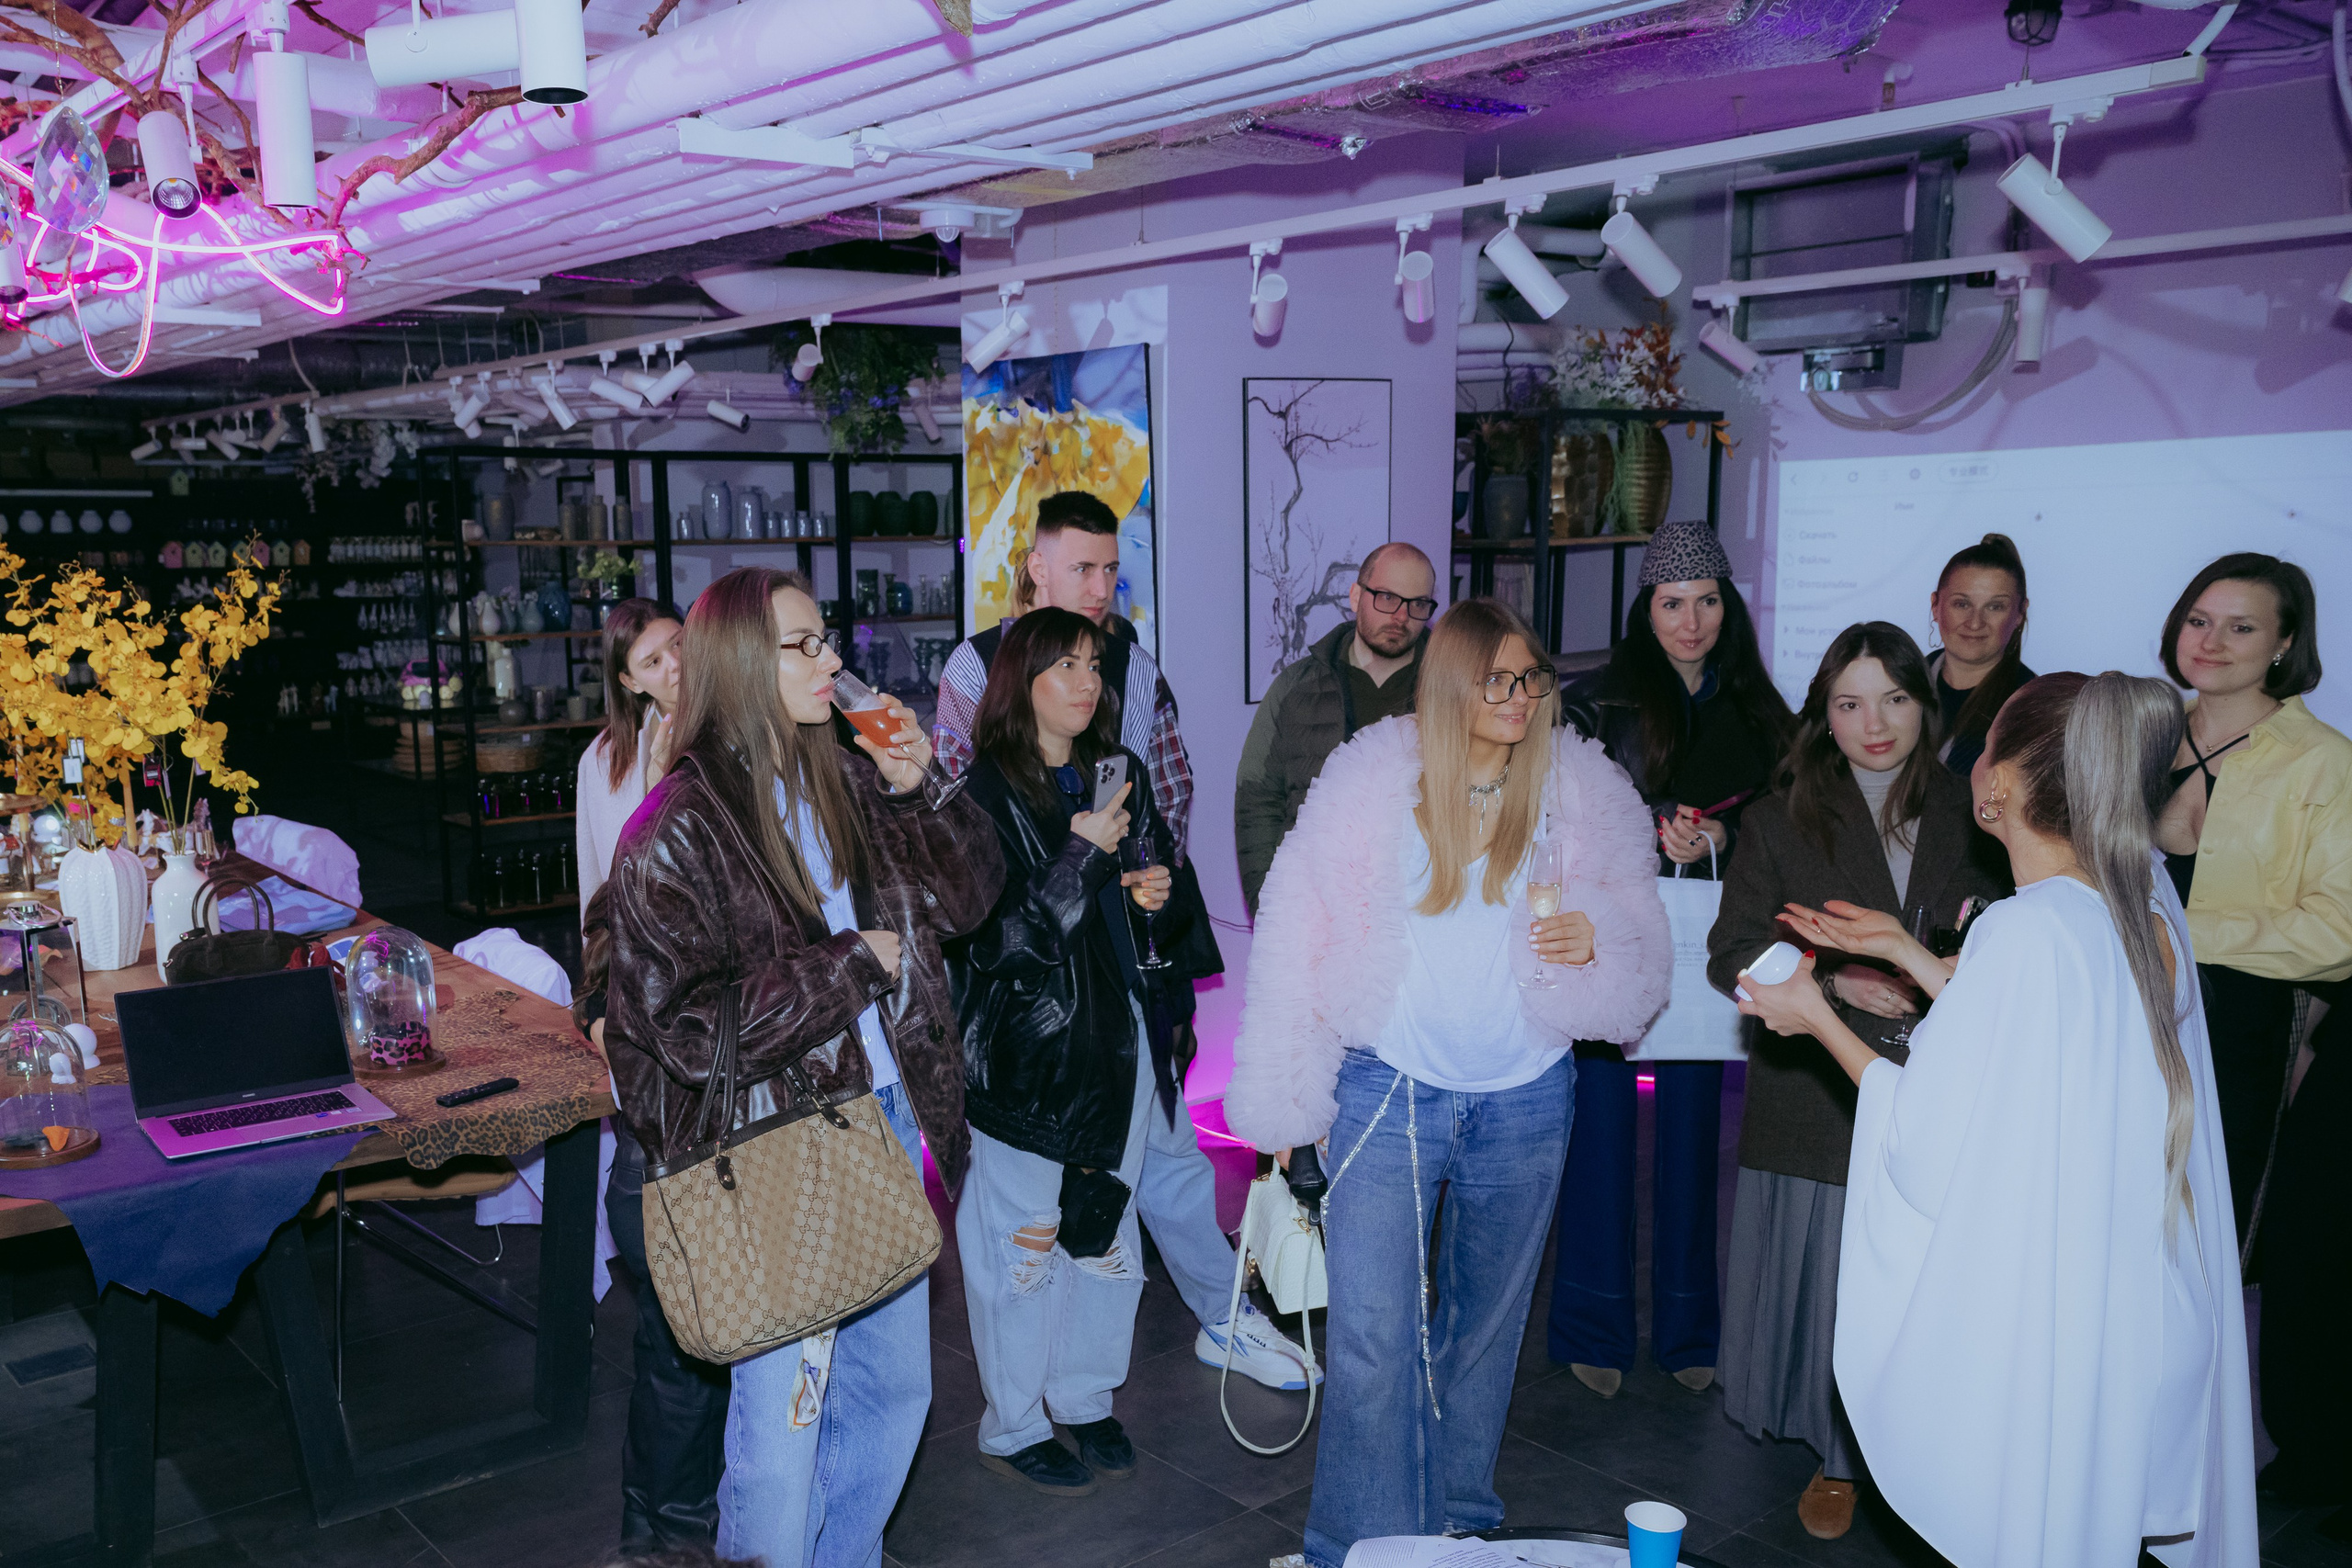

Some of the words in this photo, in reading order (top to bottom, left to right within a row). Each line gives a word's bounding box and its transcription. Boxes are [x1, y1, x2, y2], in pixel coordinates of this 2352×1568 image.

[1798, 529, 1838, 540] Скачать
[1797, 554, 1832, 565] Файлы
[1796, 579, 1858, 590] Фотоальбом
[1795, 626, 1816, 636] Мои
